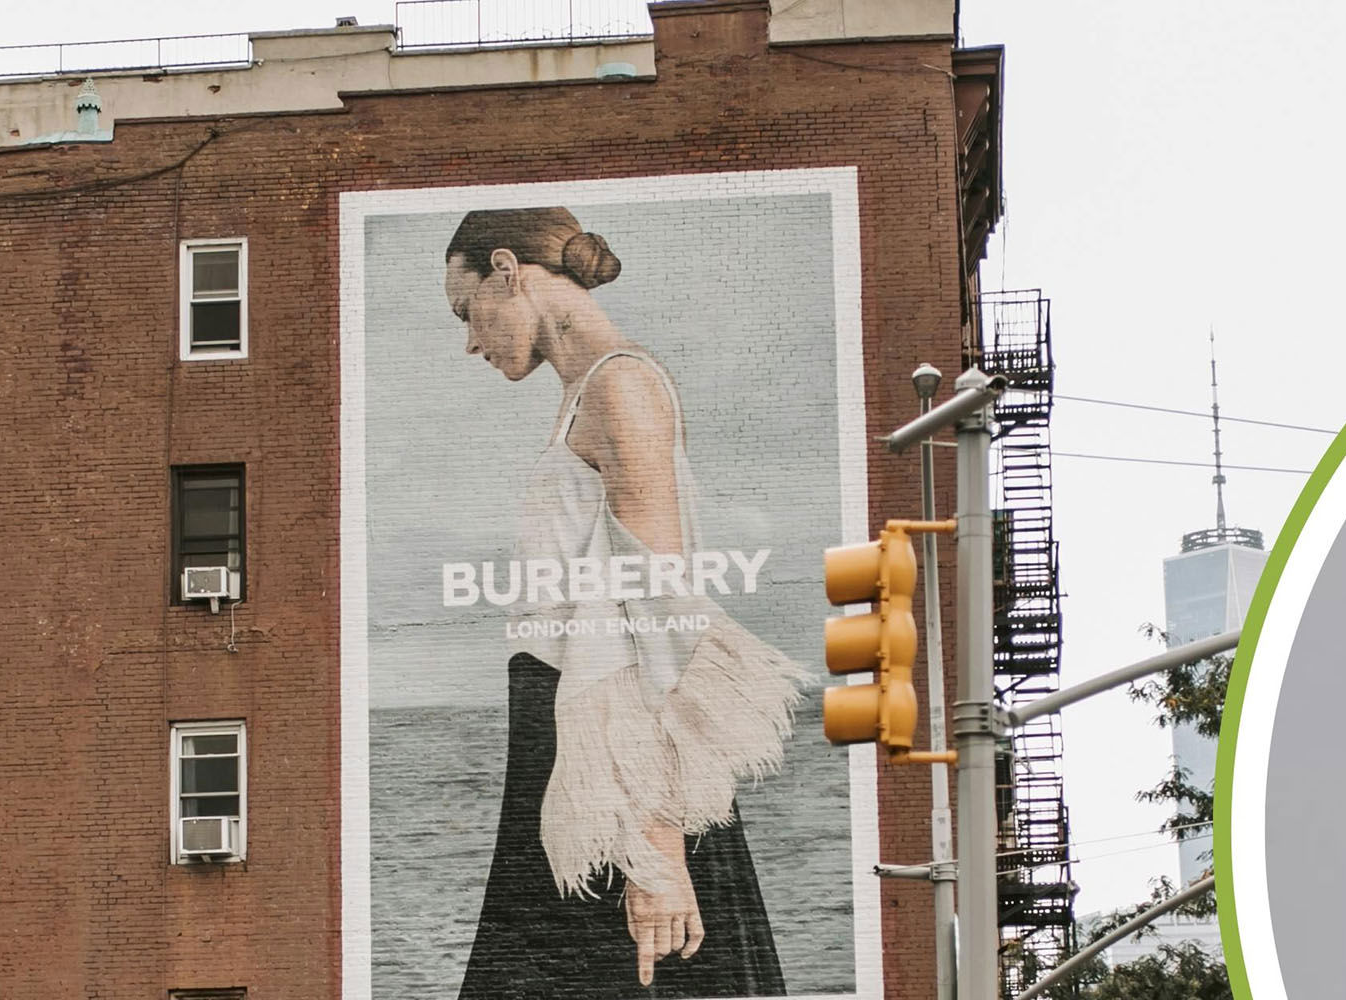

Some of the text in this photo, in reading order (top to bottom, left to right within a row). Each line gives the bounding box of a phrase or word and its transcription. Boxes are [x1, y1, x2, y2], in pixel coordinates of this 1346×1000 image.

[443, 549, 771, 606] BURBERRY
[506, 615, 710, 639] LONDON ENGLAND
